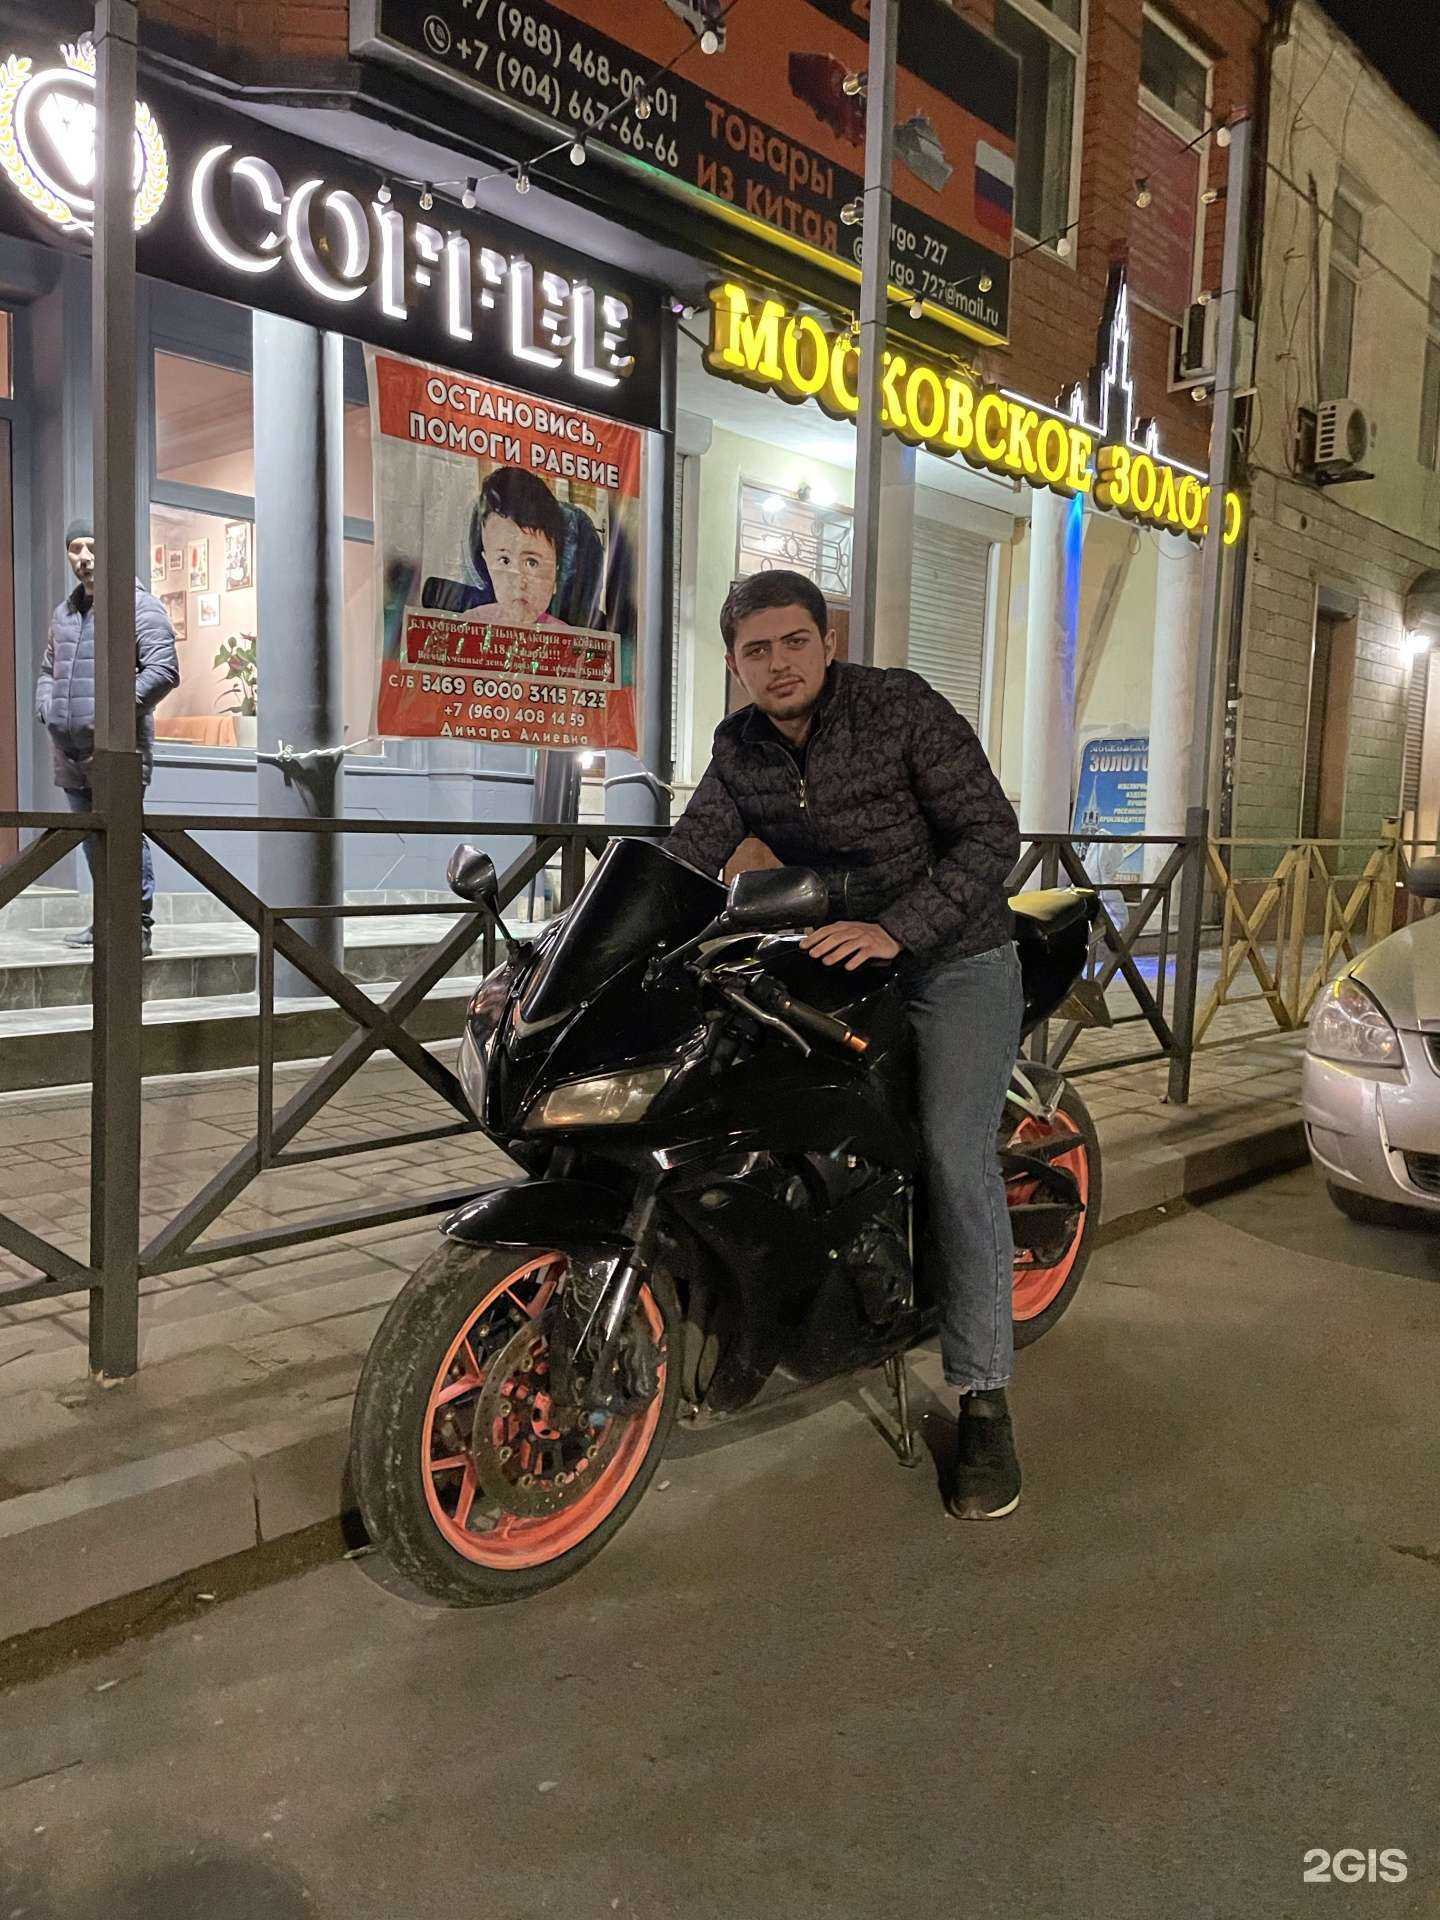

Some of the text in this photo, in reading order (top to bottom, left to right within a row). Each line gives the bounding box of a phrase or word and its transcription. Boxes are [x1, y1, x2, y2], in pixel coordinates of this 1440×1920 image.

[497, 1, 562, 68] (988)
[456, 38, 679, 168] +7 (904) 667-66-66
[190, 143, 637, 388] COFFEE
[408, 411, 620, 489] ПОМОГИ РАББИЕ
[426, 377, 603, 453] ОСТАНОВИСЬ,
[716, 282, 1241, 545] МОСКОВСКОЕ ЗОЛОО
[421, 673, 466, 696] 5469
[473, 678, 523, 700] 6000
[529, 685, 567, 705] 3115
[572, 689, 607, 709] 7423
[444, 702, 585, 727] +7 (960) 408 14 59
[440, 721, 588, 745] Динара Алиевна
